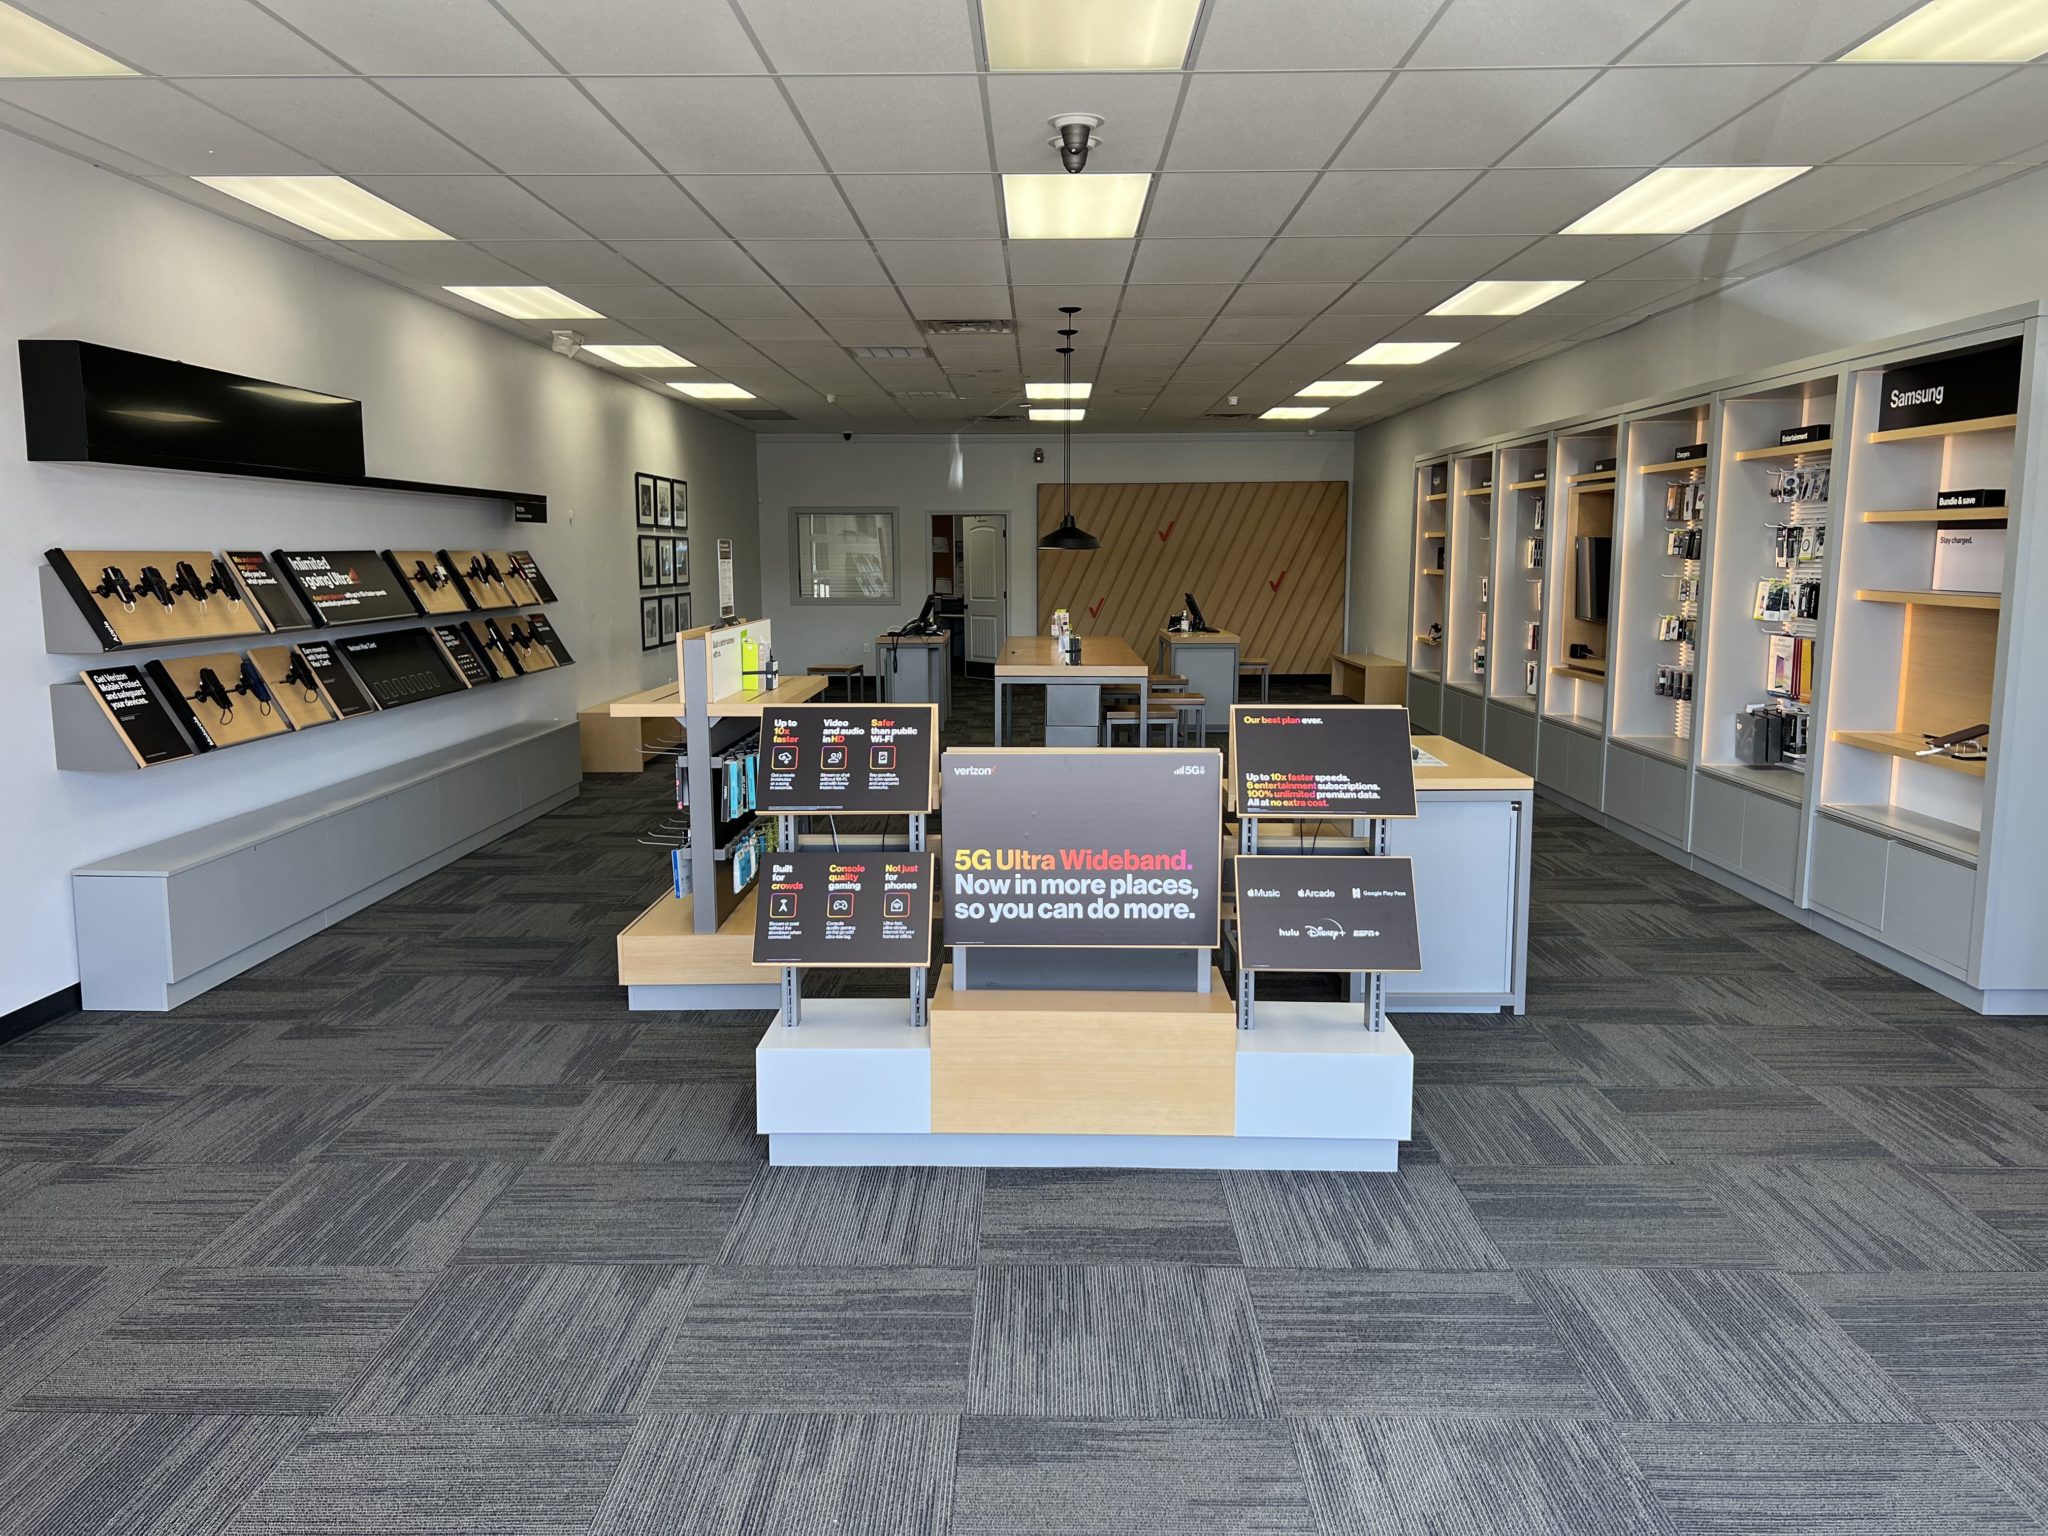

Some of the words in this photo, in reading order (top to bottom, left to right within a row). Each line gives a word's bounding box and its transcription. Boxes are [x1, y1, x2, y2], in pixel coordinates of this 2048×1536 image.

[1890, 386, 1944, 408] Samsung
[1782, 432, 1808, 442] Entertainment
[1939, 496, 1957, 506] Bundle
[1958, 496, 1962, 504] &
[1940, 536, 1950, 545] Stay
[1951, 536, 1972, 545] charged.
[305, 573, 335, 590] going
[103, 620, 120, 642] Apple
[93, 674, 107, 683] Get
[104, 672, 128, 682] Verizon
[98, 682, 120, 692] Mobile
[117, 679, 142, 689] Protect
[105, 691, 119, 700] and
[117, 687, 146, 700] safeguard
[110, 701, 125, 711] your
[124, 698, 149, 707] devices.
[774, 719, 787, 728] Up
[787, 719, 798, 727] to
[823, 719, 849, 727] Video
[871, 719, 895, 727] Safer
[1244, 716, 1260, 724] Our
[1261, 716, 1281, 724] best
[1282, 716, 1301, 726] plan
[193, 716, 215, 746] Motorola
[773, 727, 790, 735] 10x
[822, 727, 840, 735] and
[840, 727, 865, 735] audio
[870, 727, 890, 735] than
[891, 727, 918, 737] public
[773, 735, 799, 743] faster
[822, 735, 831, 743] in
[830, 735, 845, 743] HD
[870, 735, 894, 743] Wi-Fi
[954, 765, 992, 776] verizon
[1185, 765, 1200, 775] 5G
[1246, 773, 1259, 782] Up
[1270, 773, 1287, 781] 10x
[1288, 773, 1314, 781] faster
[1315, 774, 1350, 783] speeds.
[1247, 782, 1254, 790] 6
[1254, 782, 1316, 790] entertainment
[1318, 782, 1381, 791] subscriptions.
[1247, 790, 1273, 798] 100%
[1274, 790, 1316, 798] unlimited
[1316, 791, 1357, 800] premium
[1358, 790, 1380, 799] data.
[1247, 799, 1259, 807] All
[1261, 799, 1270, 807] at
[1283, 799, 1306, 807] extra
[1307, 799, 1329, 807] cost.
[954, 849, 992, 871] 5G
[996, 849, 1055, 871] Ultra
[1060, 849, 1193, 871] Wideband.
[772, 864, 793, 873] Built
[829, 864, 865, 873] Console
[885, 864, 901, 873] Not
[901, 864, 919, 874] just
[772, 873, 785, 881] for
[828, 873, 859, 882] quality
[885, 873, 898, 881] for
[771, 882, 804, 890] crowds
[828, 882, 861, 891] gaming
[884, 882, 918, 891] phones
[955, 874, 1010, 895] Now
[1014, 873, 1038, 895] in
[1041, 877, 1106, 895] more
[1110, 874, 1199, 899] places,
[1254, 889, 1280, 898] Music
[1305, 889, 1336, 898] Arcade
[954, 902, 985, 919] so
[989, 902, 1034, 924] you
[1037, 902, 1083, 919] can
[1087, 898, 1119, 919] do
[1124, 902, 1196, 919] more.
[1279, 928, 1299, 937] hulu
